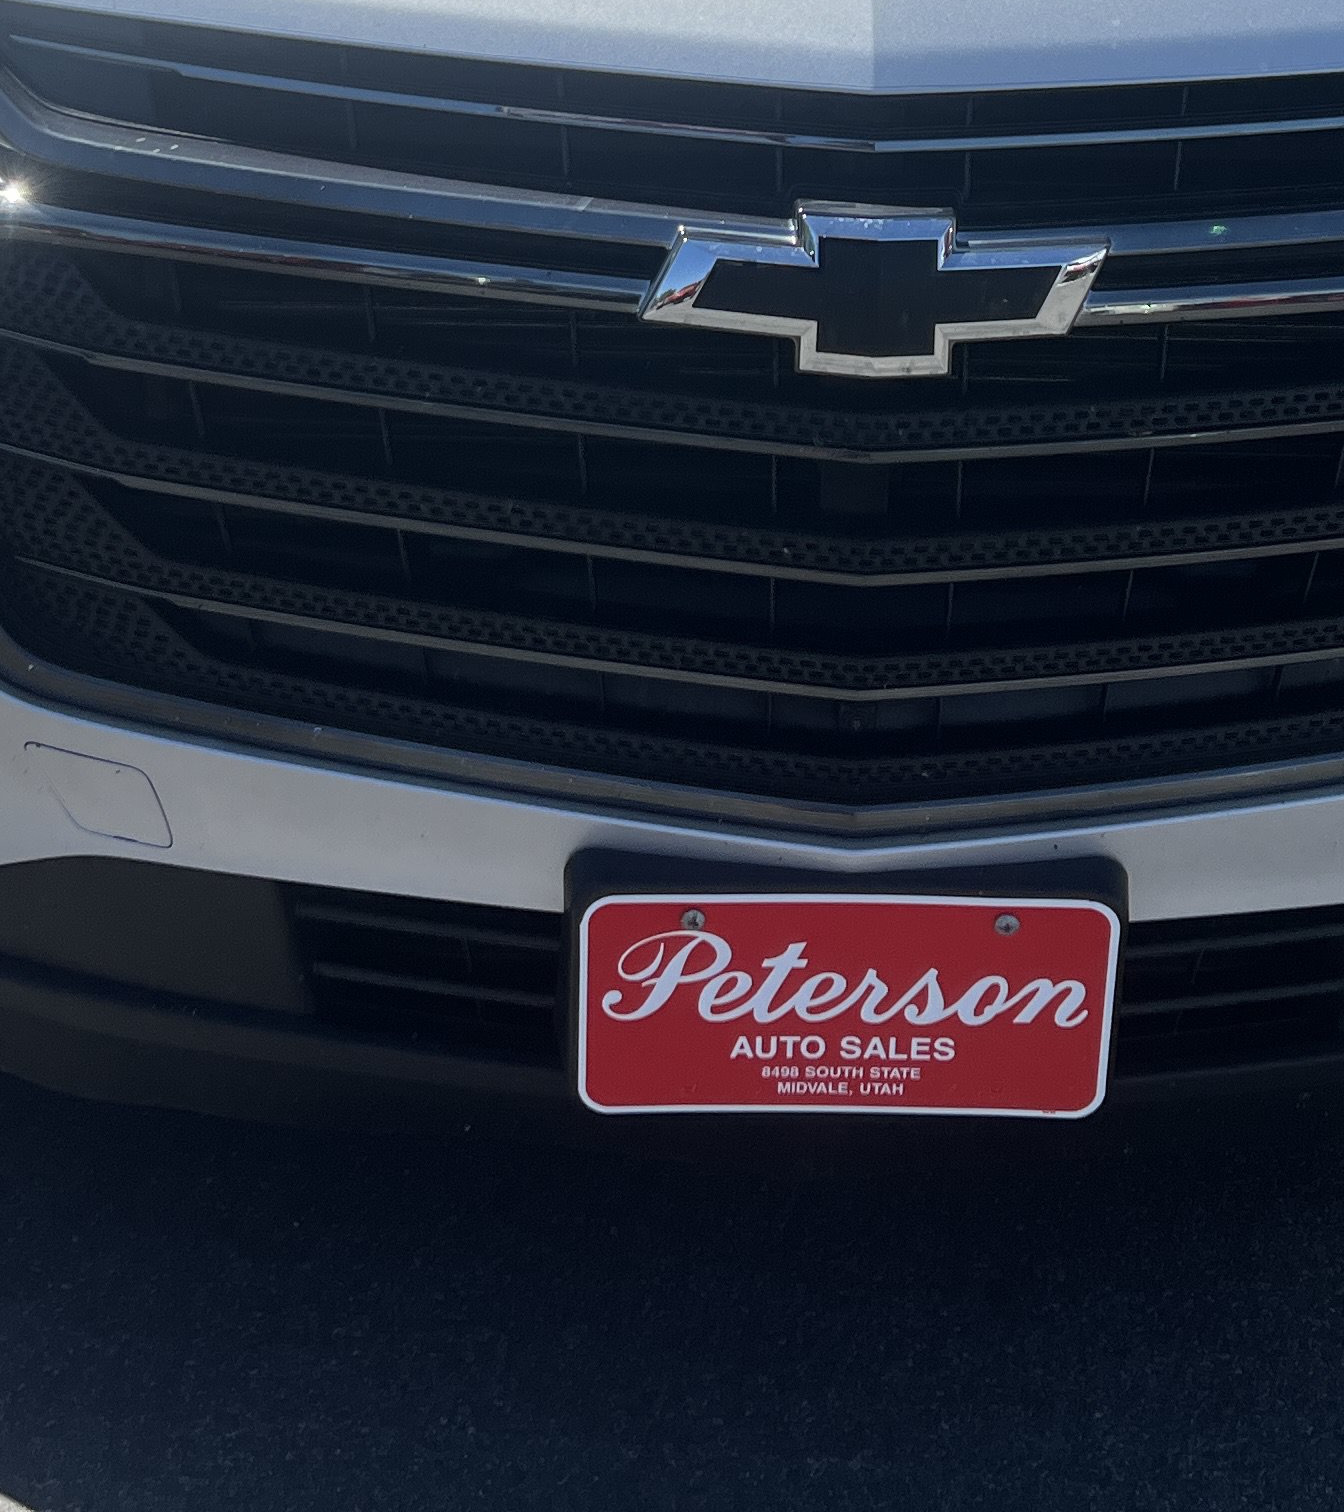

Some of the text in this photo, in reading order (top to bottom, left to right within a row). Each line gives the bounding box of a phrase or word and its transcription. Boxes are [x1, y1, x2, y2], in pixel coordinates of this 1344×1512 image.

[602, 930, 1088, 1029] Peterson
[730, 1035, 955, 1061] AUTO SALES
[762, 1066, 921, 1080] 8498 SOUTH STATE
[777, 1082, 904, 1096] MIDVALE, UTAH
